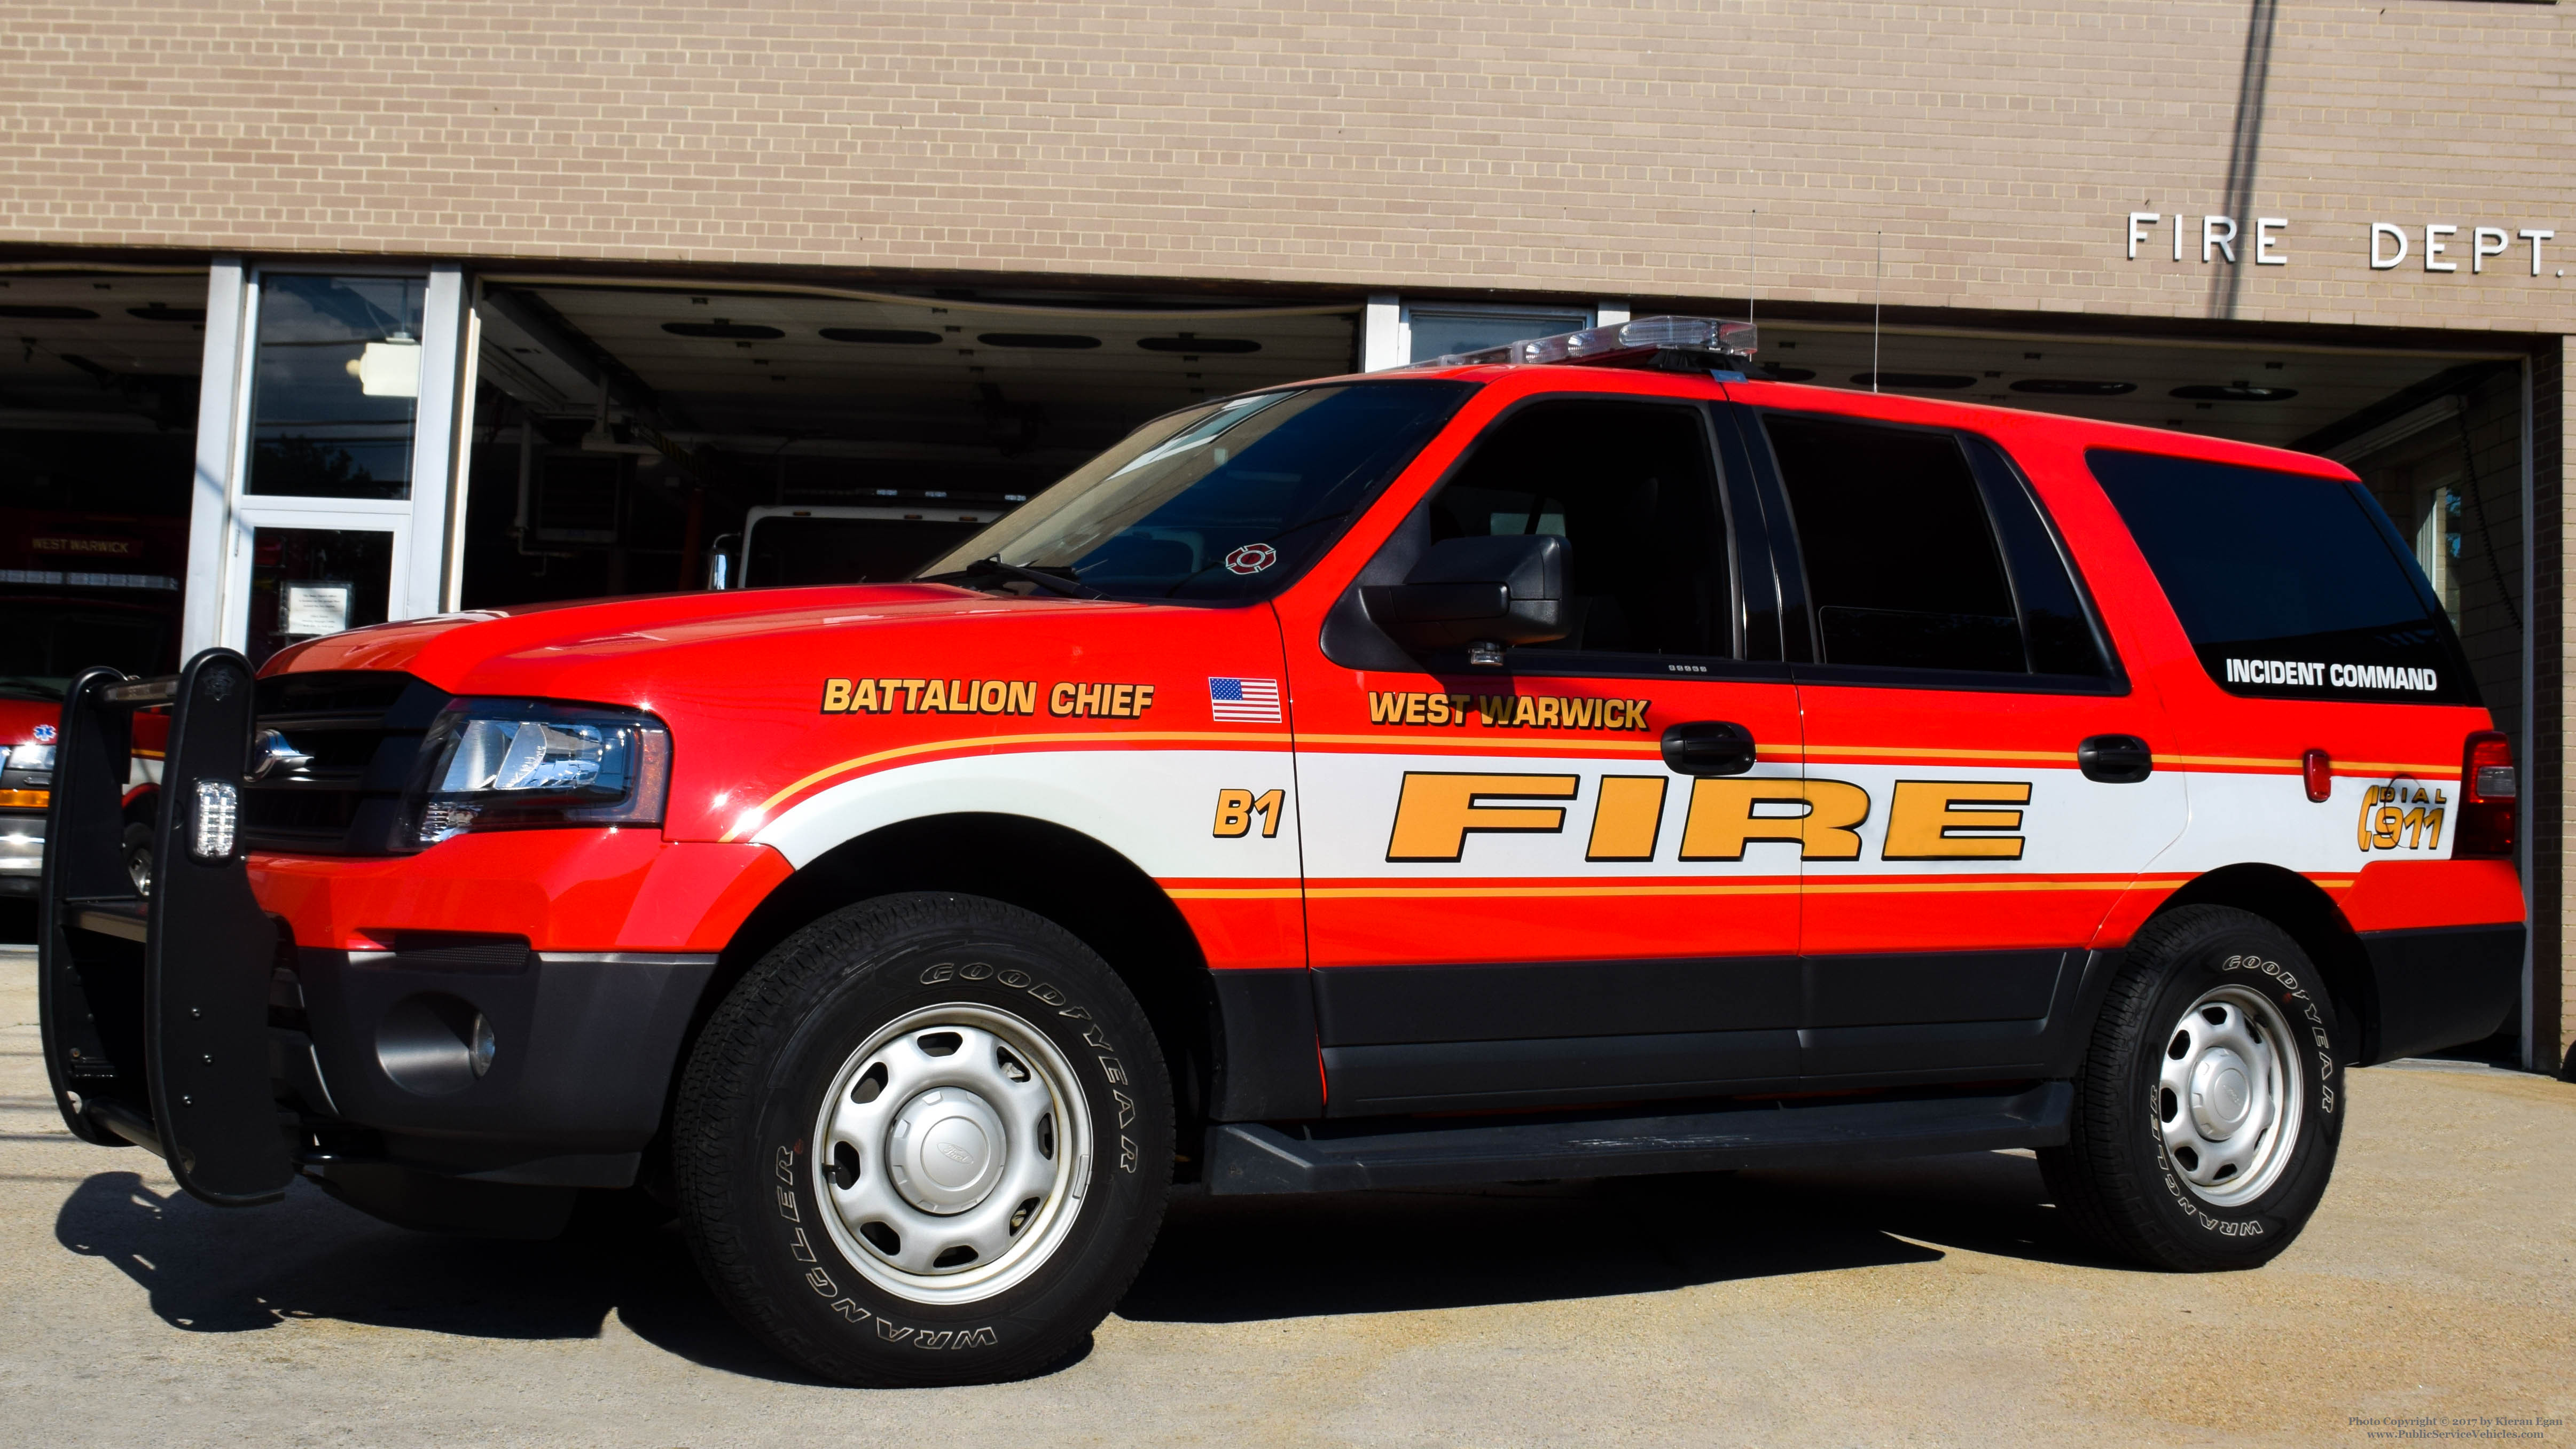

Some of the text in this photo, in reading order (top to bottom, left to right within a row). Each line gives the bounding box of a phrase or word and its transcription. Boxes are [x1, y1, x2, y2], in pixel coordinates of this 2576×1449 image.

[2127, 212, 2564, 278] FIRE DEPT.
[33, 538, 128, 553] WEST WARWICK
[820, 677, 1155, 720] BATTALION CHIEF
[2226, 658, 2437, 691] INCIDENT COMMAND
[1368, 690, 1651, 731] WEST WARWICK
[1212, 788, 1285, 839] B1
[1385, 770, 2033, 863] FIRE
[2379, 786, 2447, 804] DIAL
[2373, 806, 2445, 851] 911
[2222, 955, 2334, 1114] GOODYEAR
[920, 962, 1140, 1175] GOODYEAR
[2151, 1084, 2264, 1237] WRANGLER
[775, 1145, 998, 1351] WRANGLER
